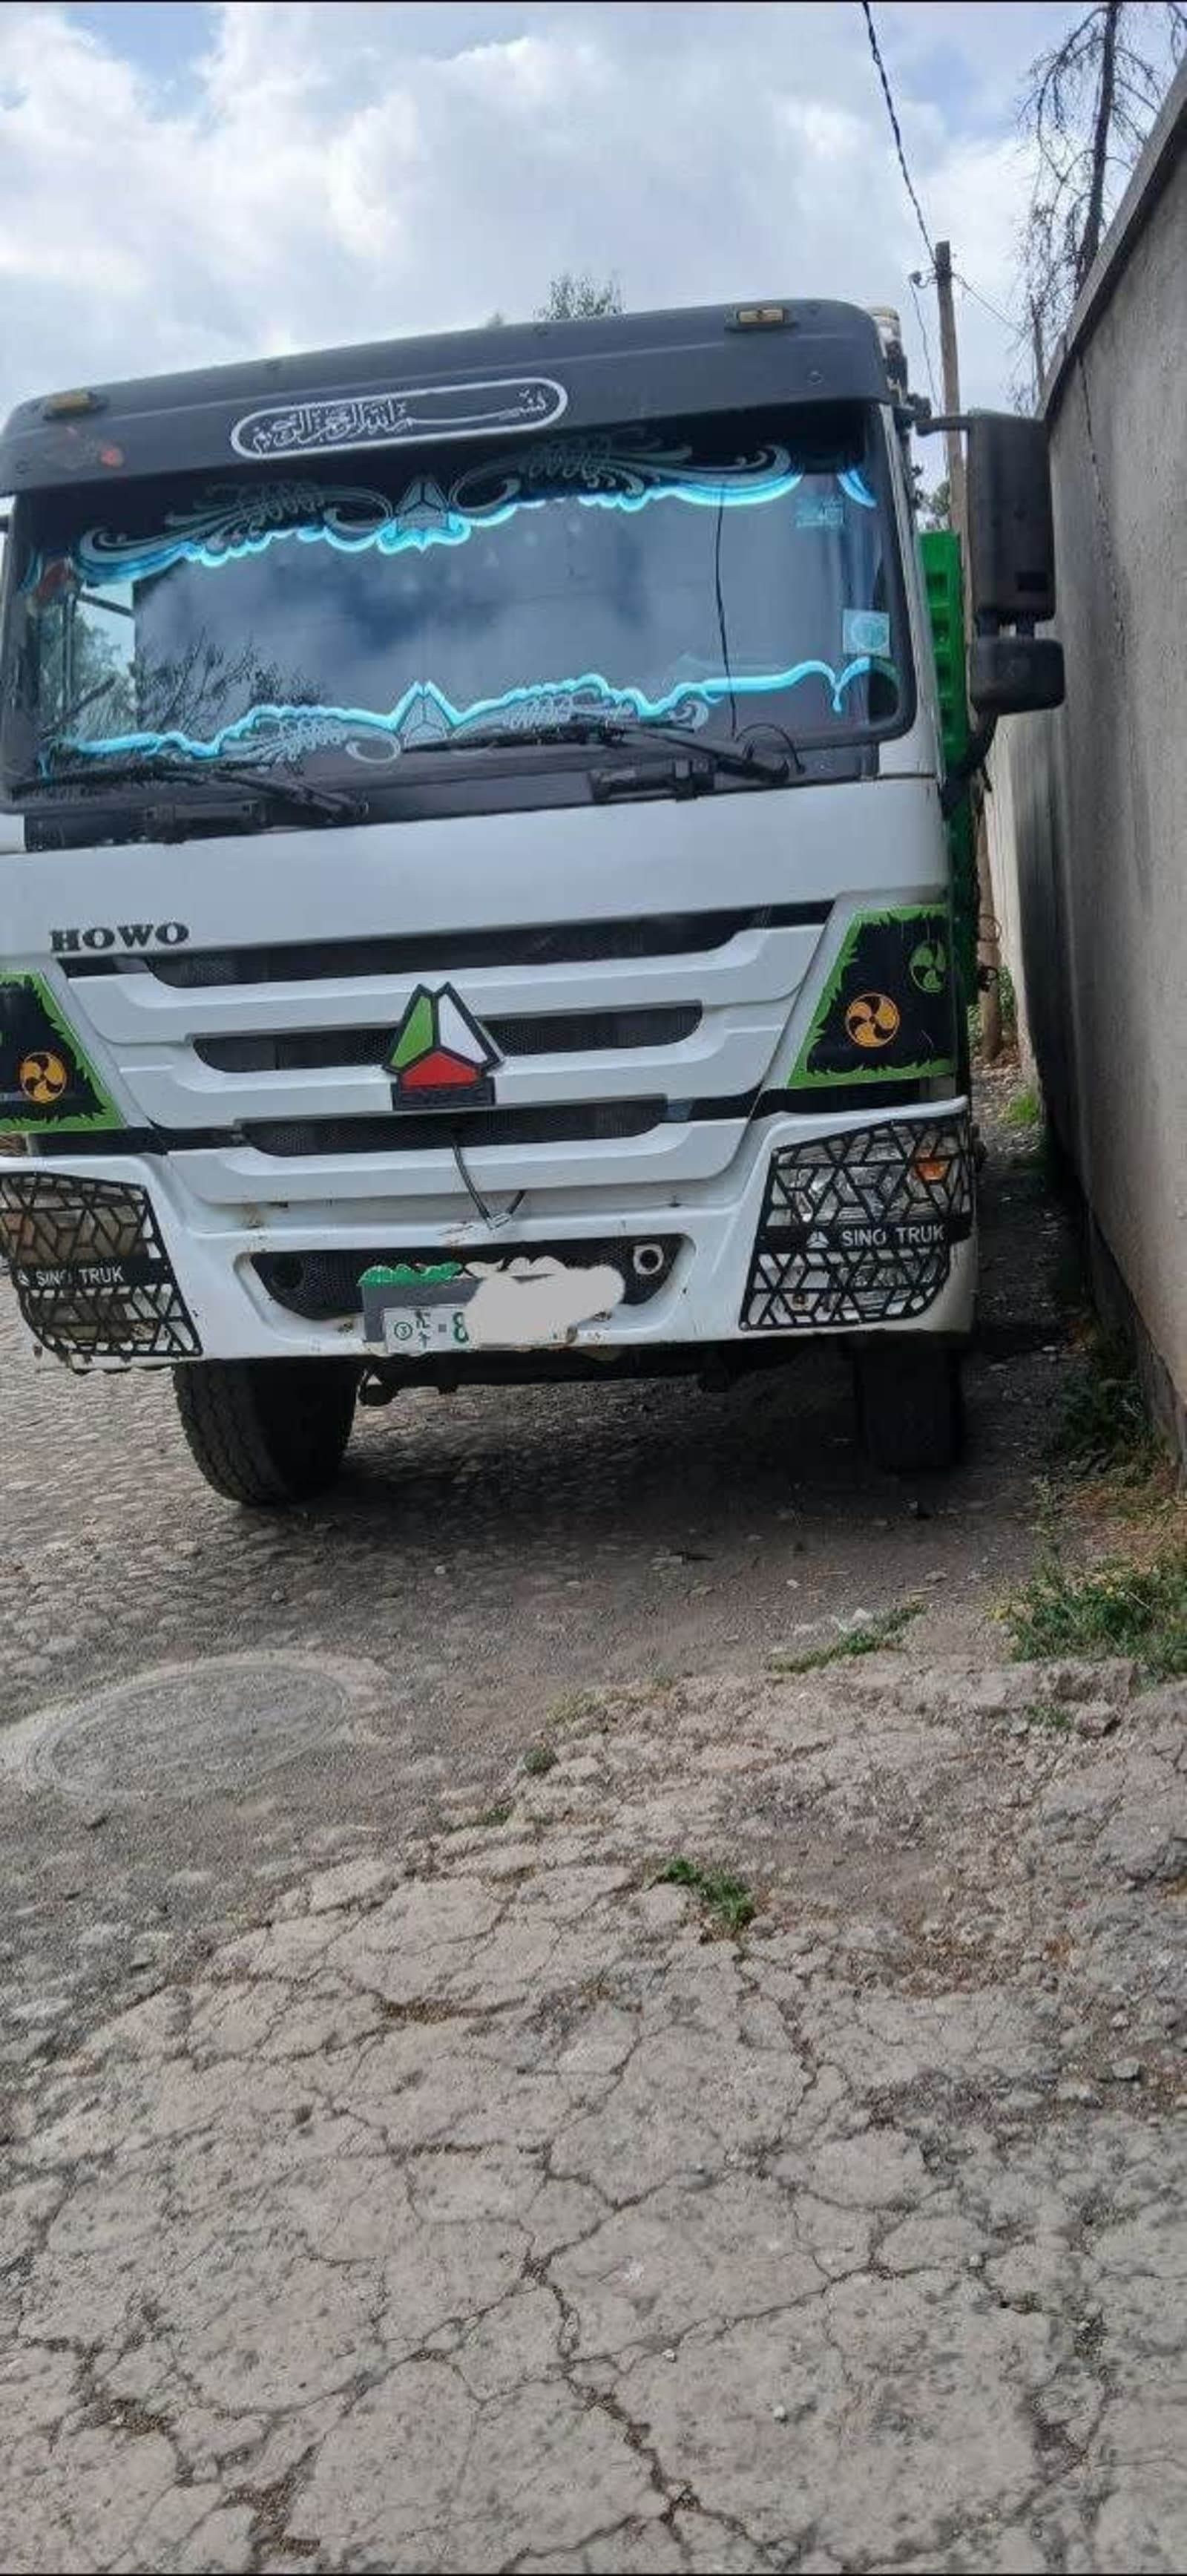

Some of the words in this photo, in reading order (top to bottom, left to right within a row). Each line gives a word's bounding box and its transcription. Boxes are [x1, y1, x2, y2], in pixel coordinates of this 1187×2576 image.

[49, 922, 189, 952] HOWO
[842, 1228, 887, 1247] SINO
[895, 1225, 944, 1244] TRUK
[78, 1265, 124, 1284] TRUK
